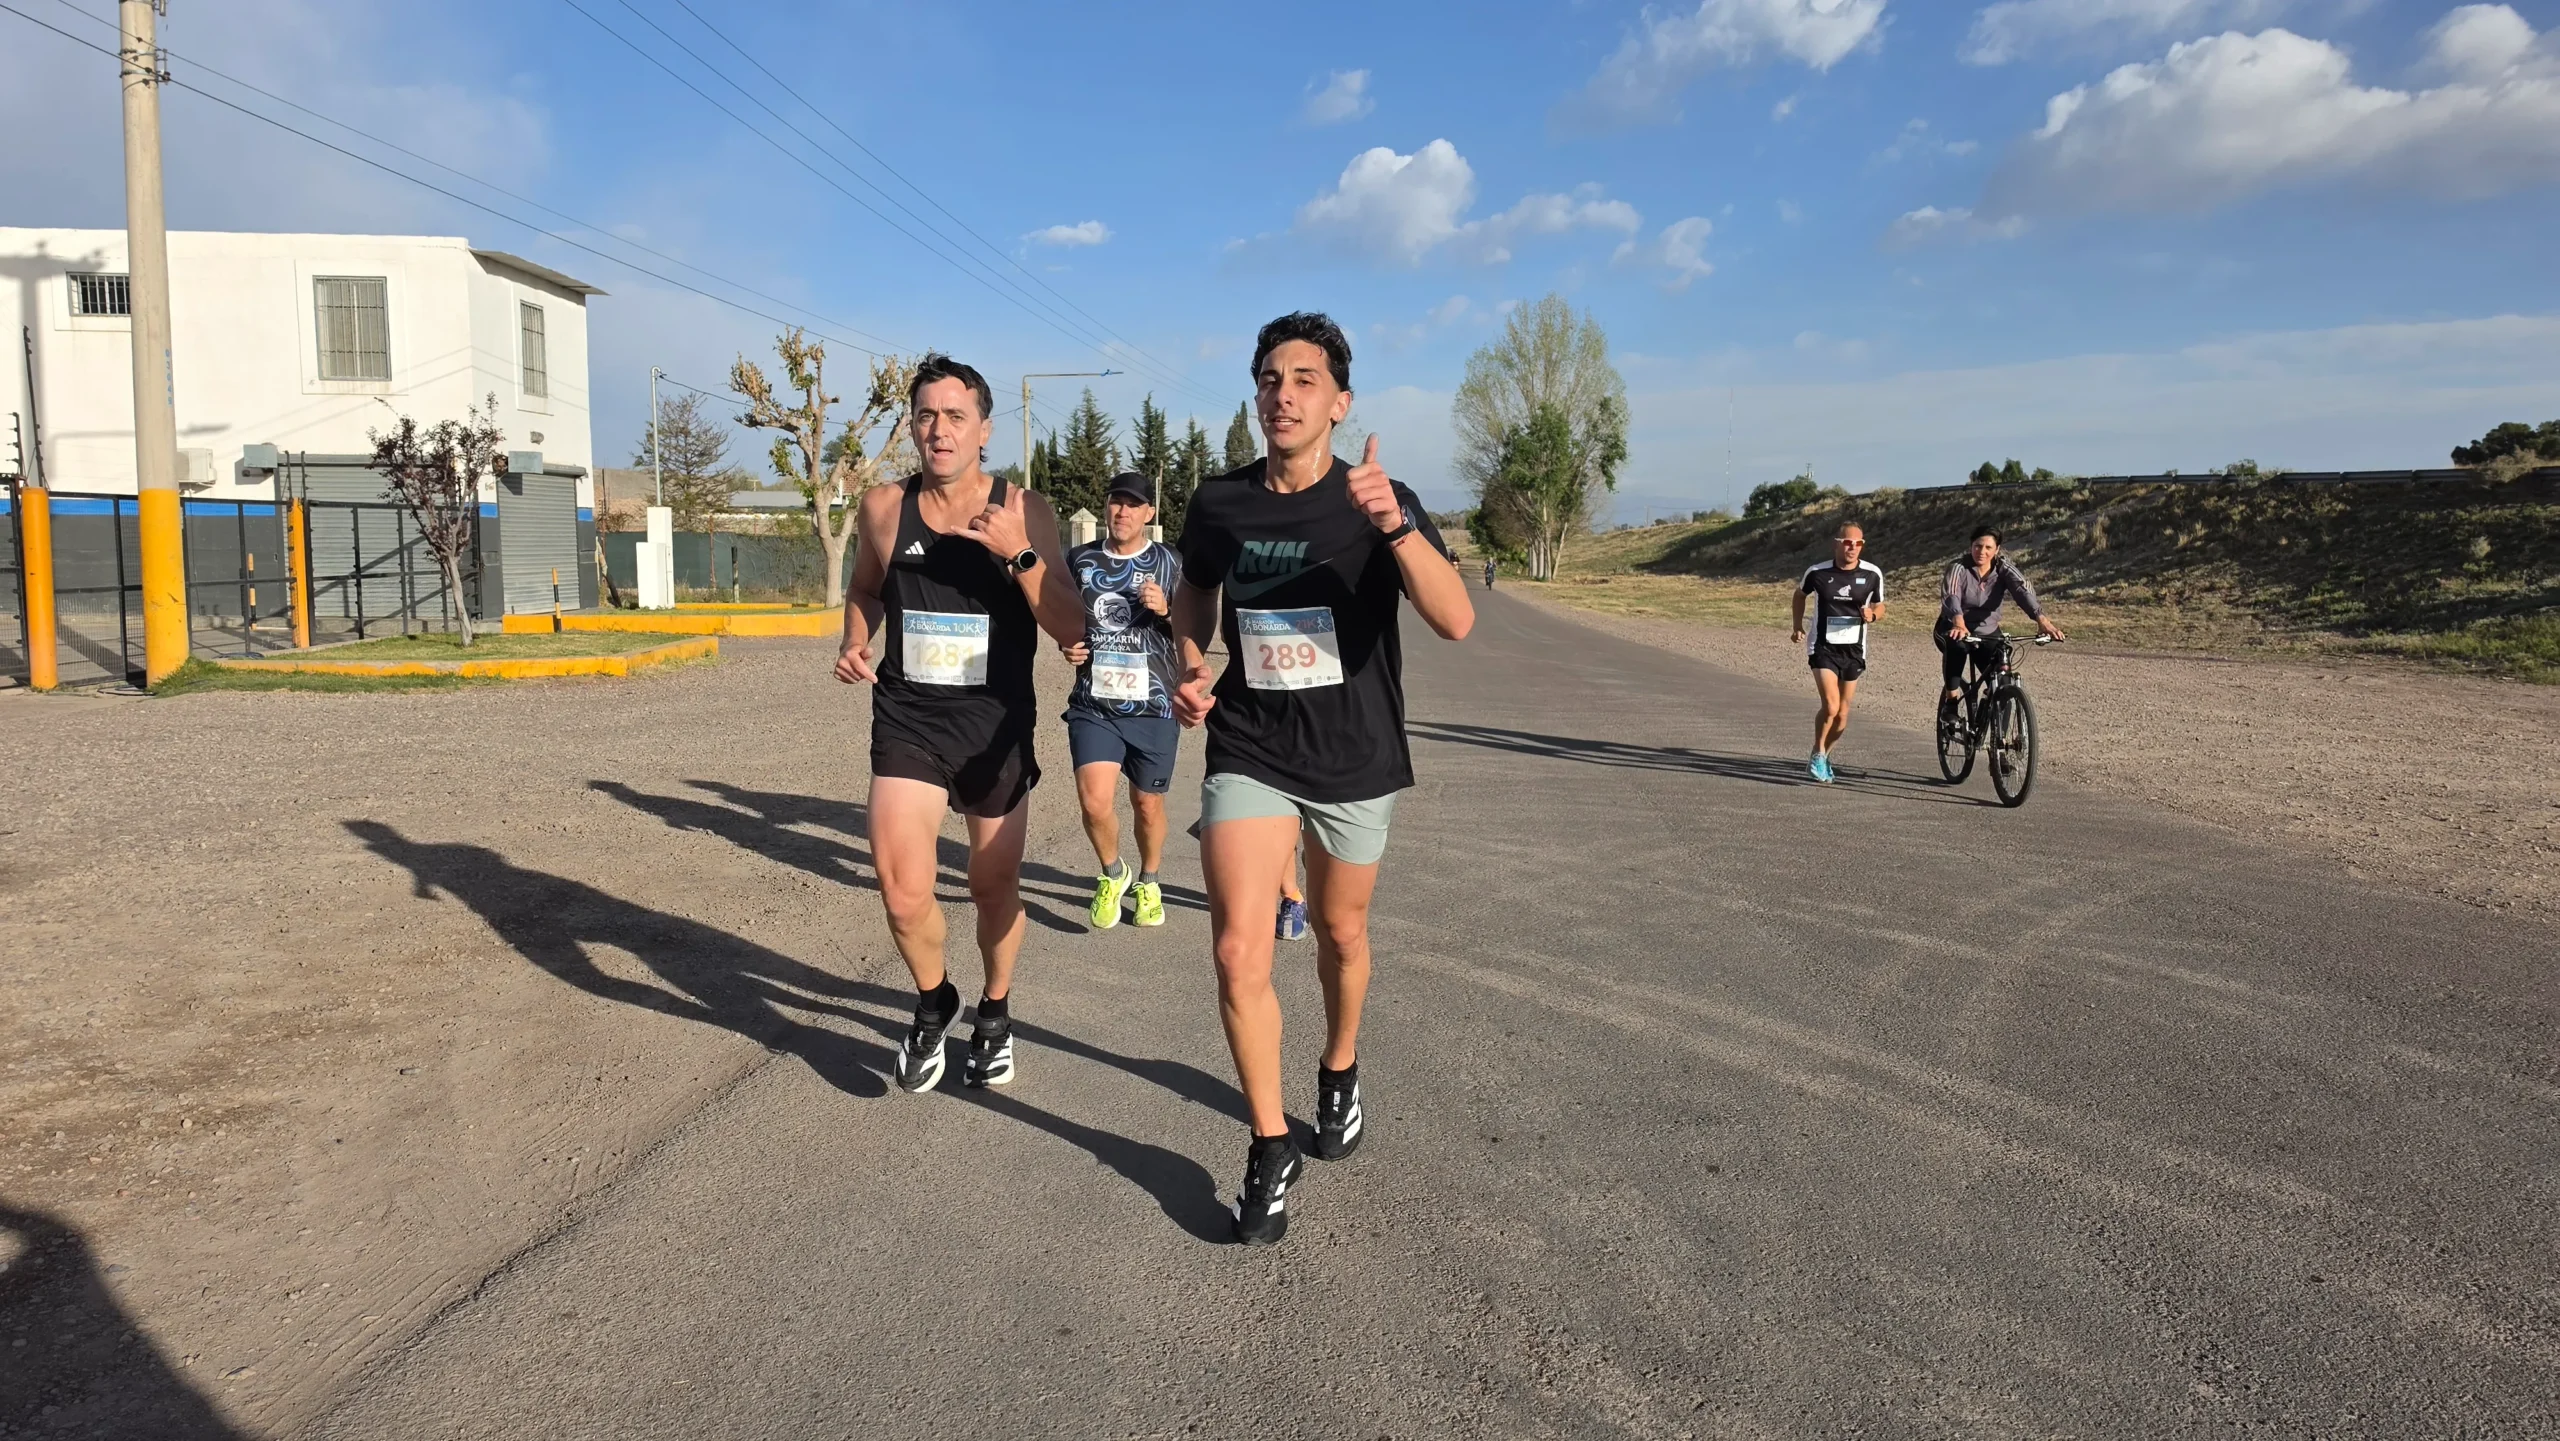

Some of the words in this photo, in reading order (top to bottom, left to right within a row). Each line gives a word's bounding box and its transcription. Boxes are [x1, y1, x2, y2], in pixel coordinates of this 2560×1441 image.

[1236, 540, 1310, 574] RUN
[917, 623, 951, 632] BONARDA
[953, 623, 975, 633] 10K
[1252, 623, 1291, 631] BONARDA
[1296, 617, 1316, 630] 21K
[1091, 633, 1106, 642] SAN
[911, 640, 975, 668] 1281
[1258, 642, 1316, 671] 289
[1103, 670, 1137, 689] 272
